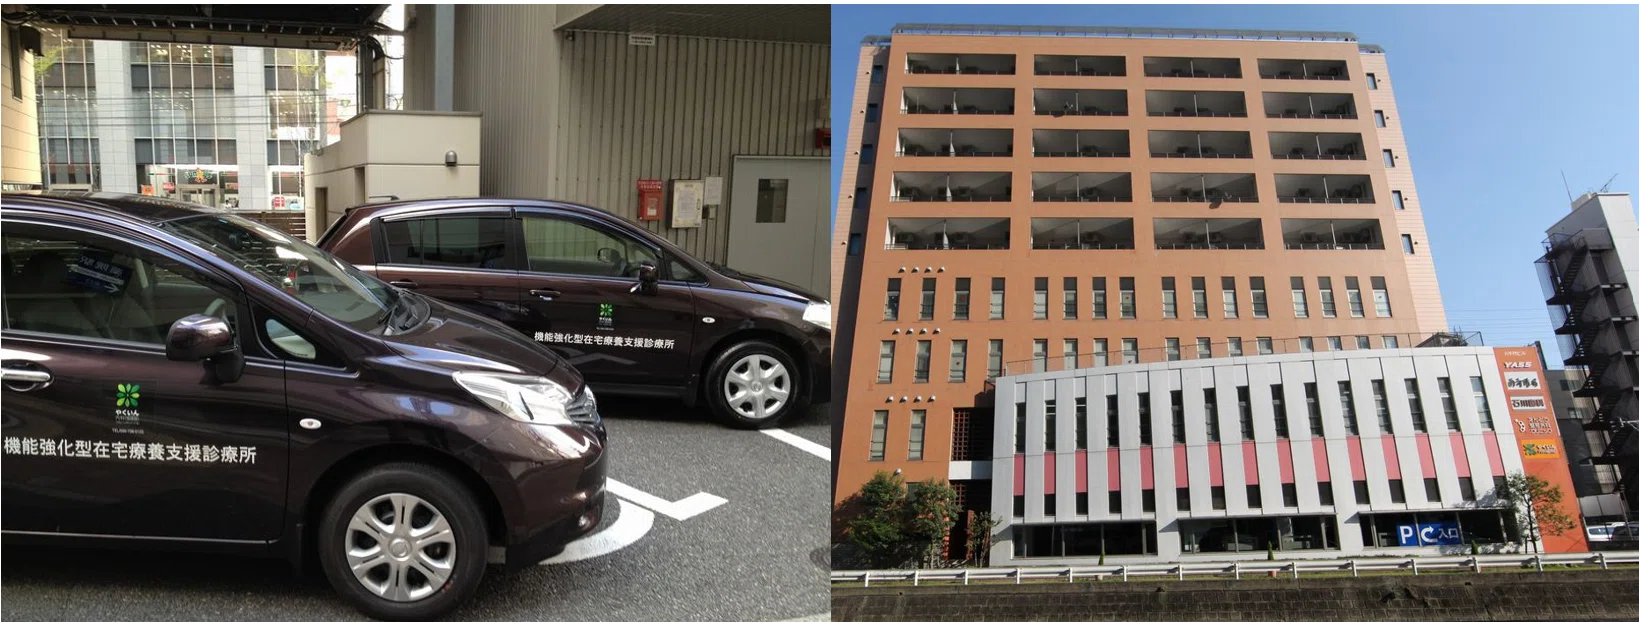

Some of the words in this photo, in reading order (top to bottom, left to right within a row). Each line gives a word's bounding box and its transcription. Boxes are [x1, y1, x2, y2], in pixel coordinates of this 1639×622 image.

[534, 331, 675, 350] 機能強化型在宅療養支援診療所
[1503, 361, 1532, 369] YASS
[115, 409, 140, 417] やくいん
[3, 436, 257, 465] 機能強化型在宅療養支援診療所
[1400, 525, 1413, 544] P
[1438, 528, 1459, 539] 入口
